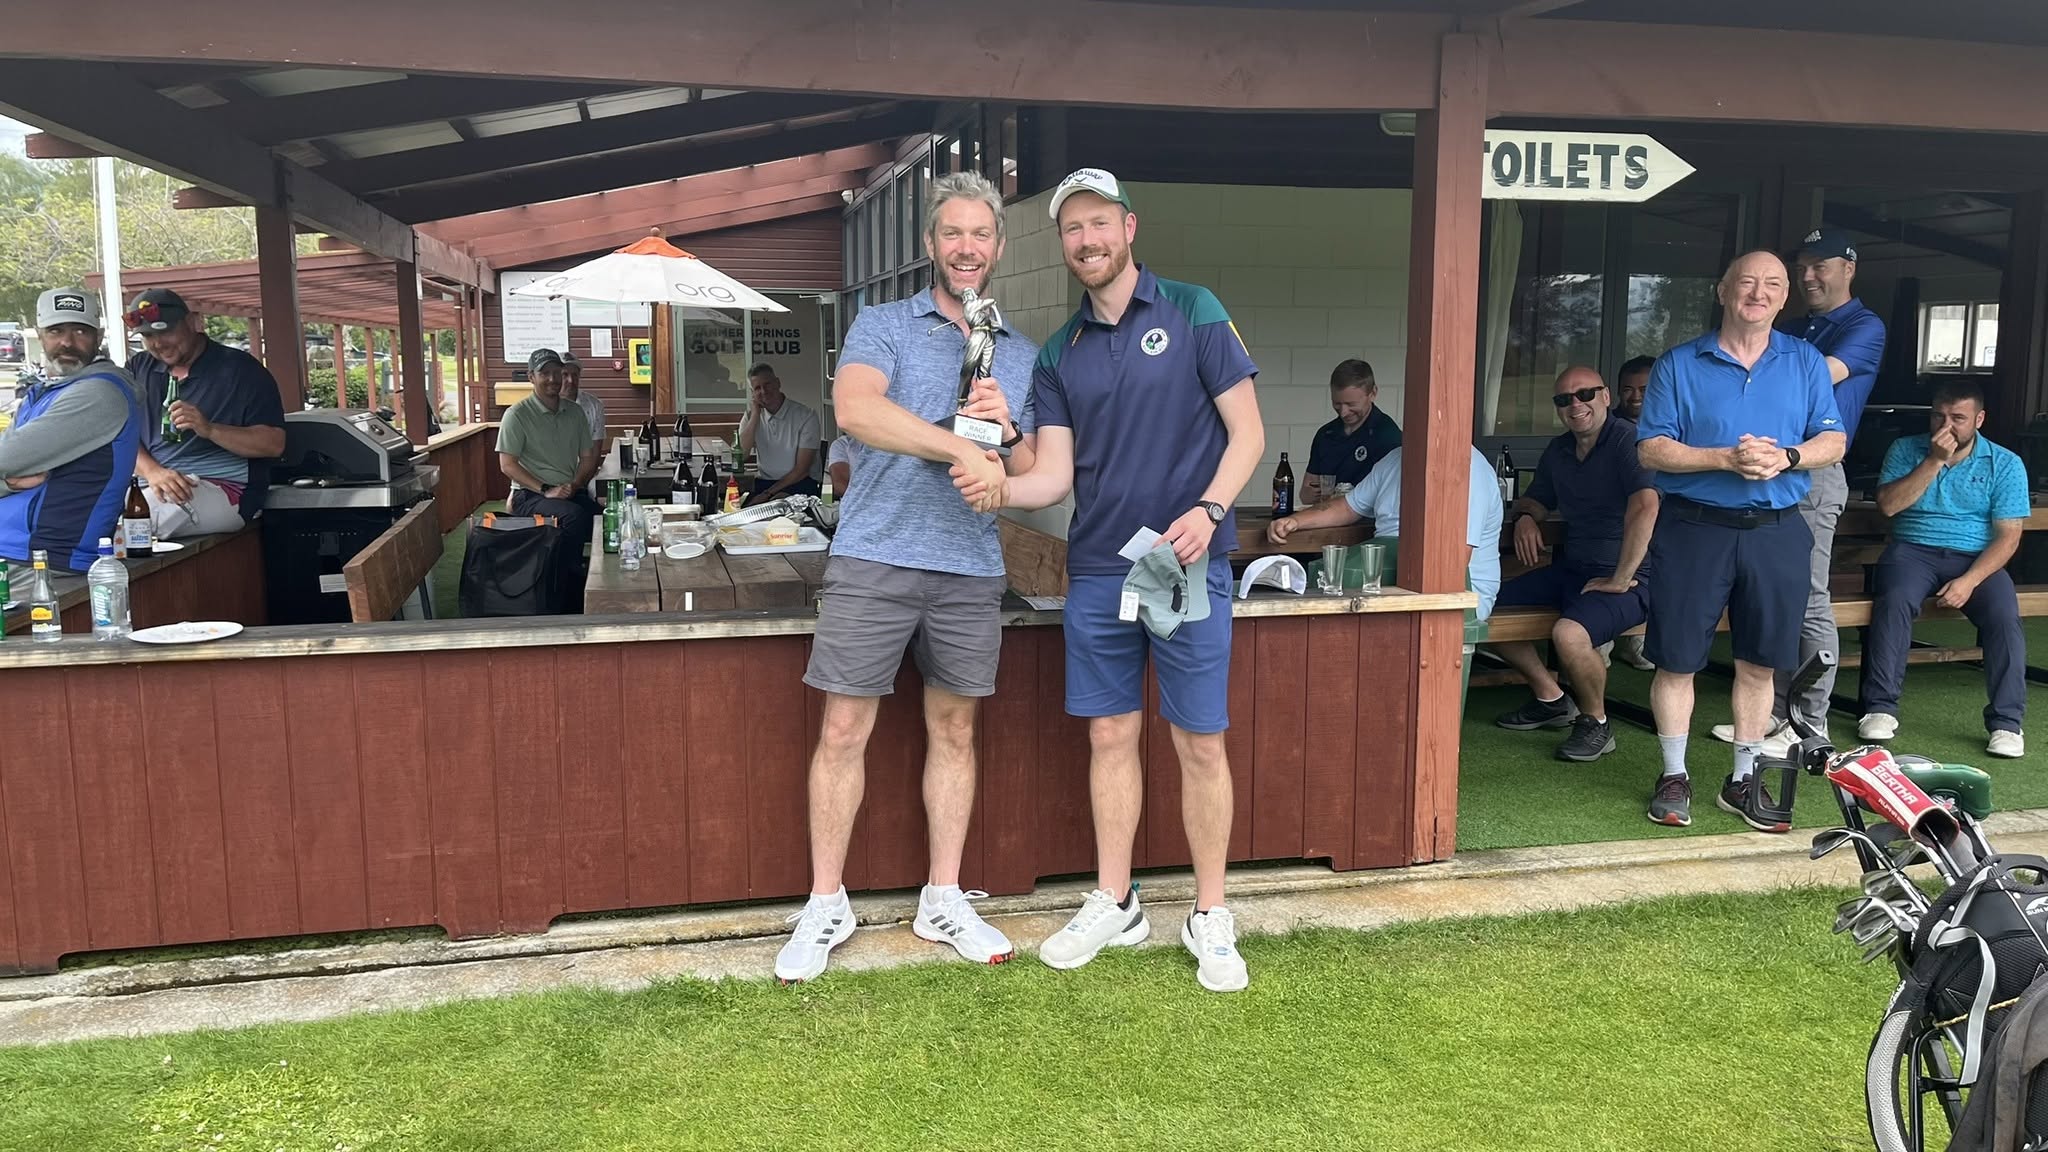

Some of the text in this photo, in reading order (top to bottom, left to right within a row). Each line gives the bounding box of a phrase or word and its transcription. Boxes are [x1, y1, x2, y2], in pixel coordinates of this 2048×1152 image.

[1484, 140, 1650, 190] OILETS
[675, 283, 737, 303] org
[751, 328, 801, 338] PRINGS
[752, 340, 801, 355] CLUB
[1871, 765, 1919, 805] BERTHA
